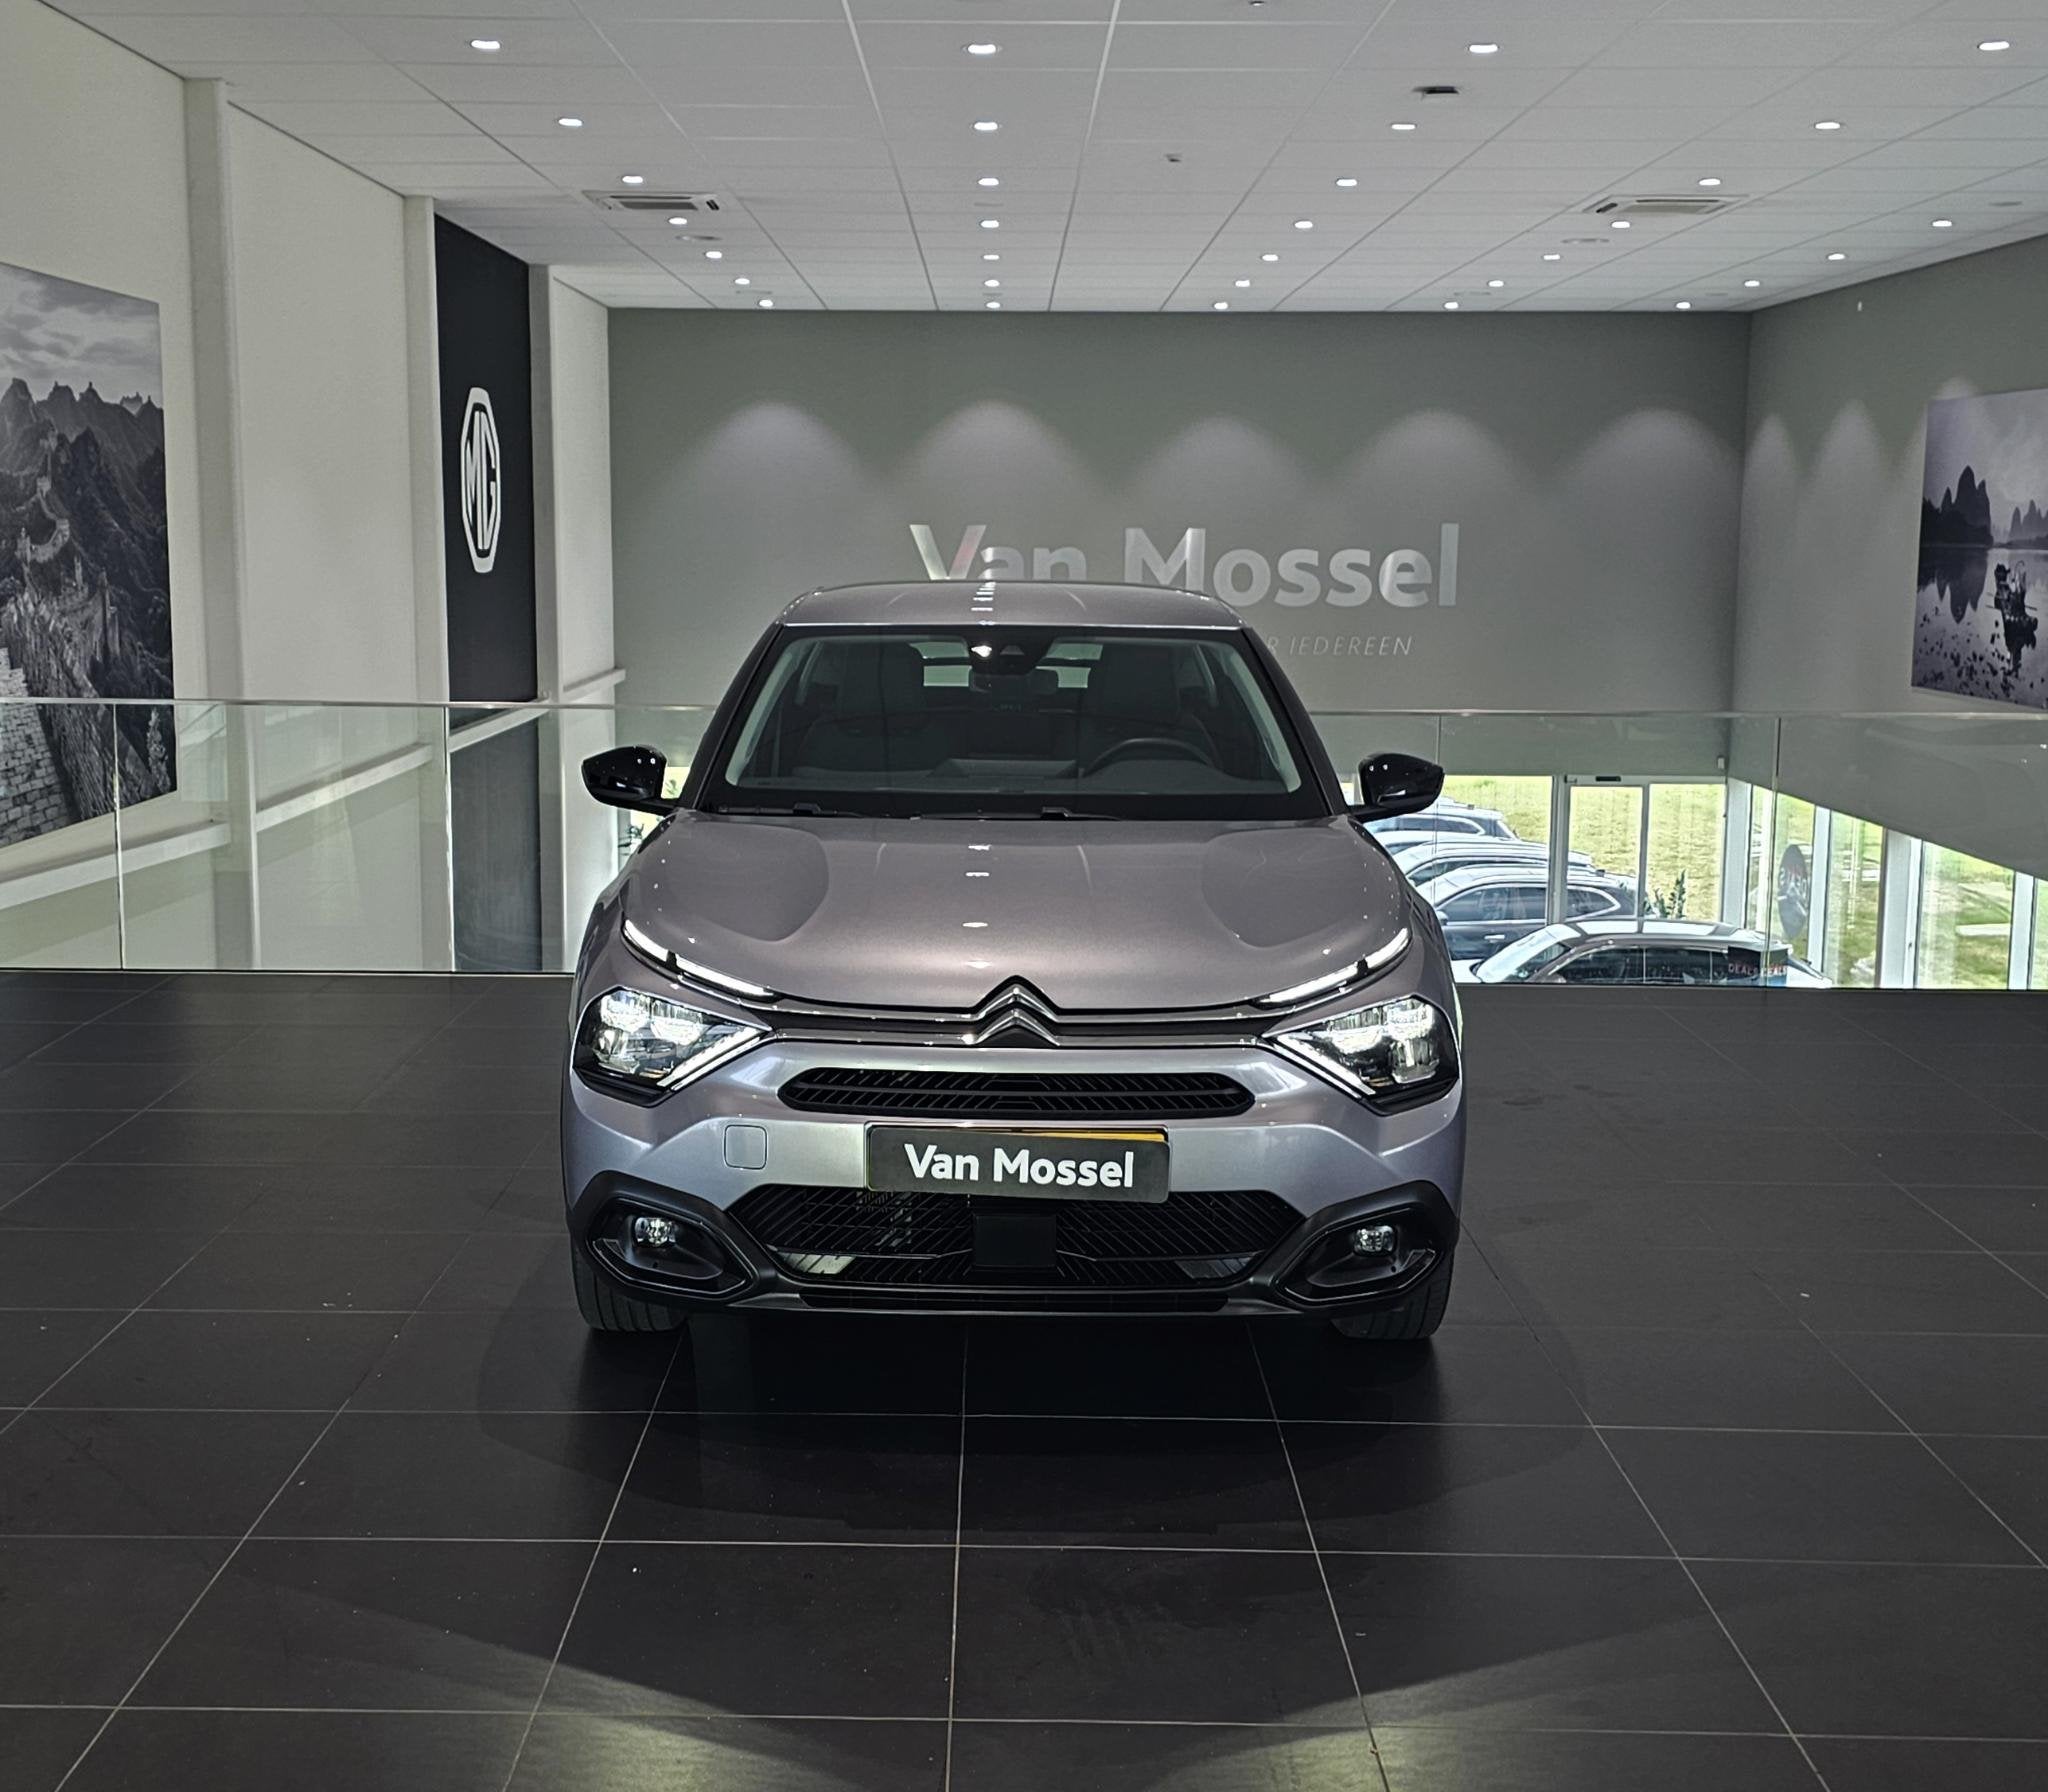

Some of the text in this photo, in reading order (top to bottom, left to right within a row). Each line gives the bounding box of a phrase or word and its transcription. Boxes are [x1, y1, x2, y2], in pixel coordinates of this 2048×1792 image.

[466, 410, 497, 550] MG
[909, 523, 1459, 607] Van Mossel
[1289, 635, 1413, 656] IEDEREEN
[904, 1143, 1134, 1188] Van Mossel
